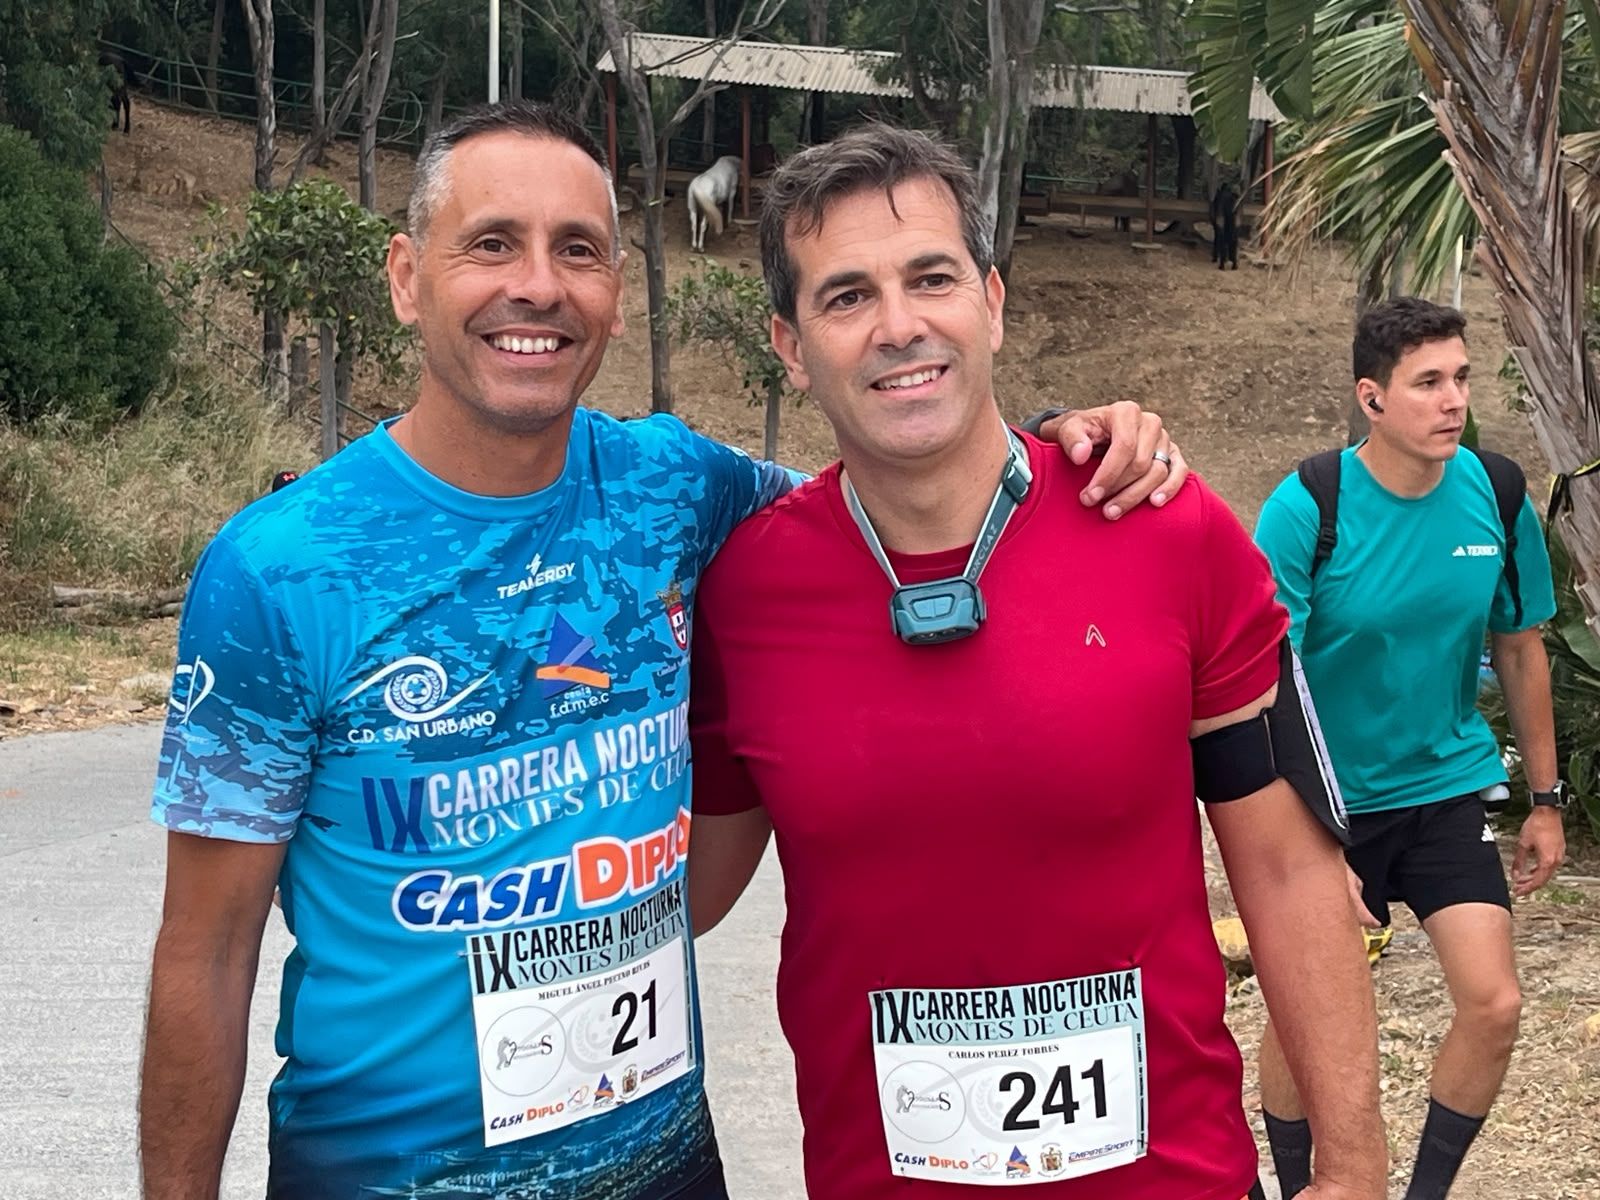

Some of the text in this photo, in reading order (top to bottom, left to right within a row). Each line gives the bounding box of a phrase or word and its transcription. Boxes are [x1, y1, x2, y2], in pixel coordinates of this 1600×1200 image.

[348, 710, 497, 744] C.D. SAN URBANO
[361, 777, 431, 854] IX
[428, 738, 588, 820] CARRERA
[431, 785, 585, 850] MONTES
[597, 769, 641, 810] DE
[393, 808, 691, 930] CASH DIPLO
[471, 881, 682, 994] IX CARRERA NOCTURNA
[518, 912, 684, 985] MONTES DE CEUTA
[538, 987, 573, 1001] MIGUEL
[611, 979, 657, 1056] 21
[872, 972, 1137, 1043] IX CARRERA NOCTURNA
[915, 1002, 1139, 1044] MONTES DE CEUTA
[948, 1050, 985, 1059] CARLOS
[490, 1103, 564, 1130] CASH DIPLO
[999, 1059, 1107, 1131] 241
[894, 1152, 969, 1170] CASH DIPLO
